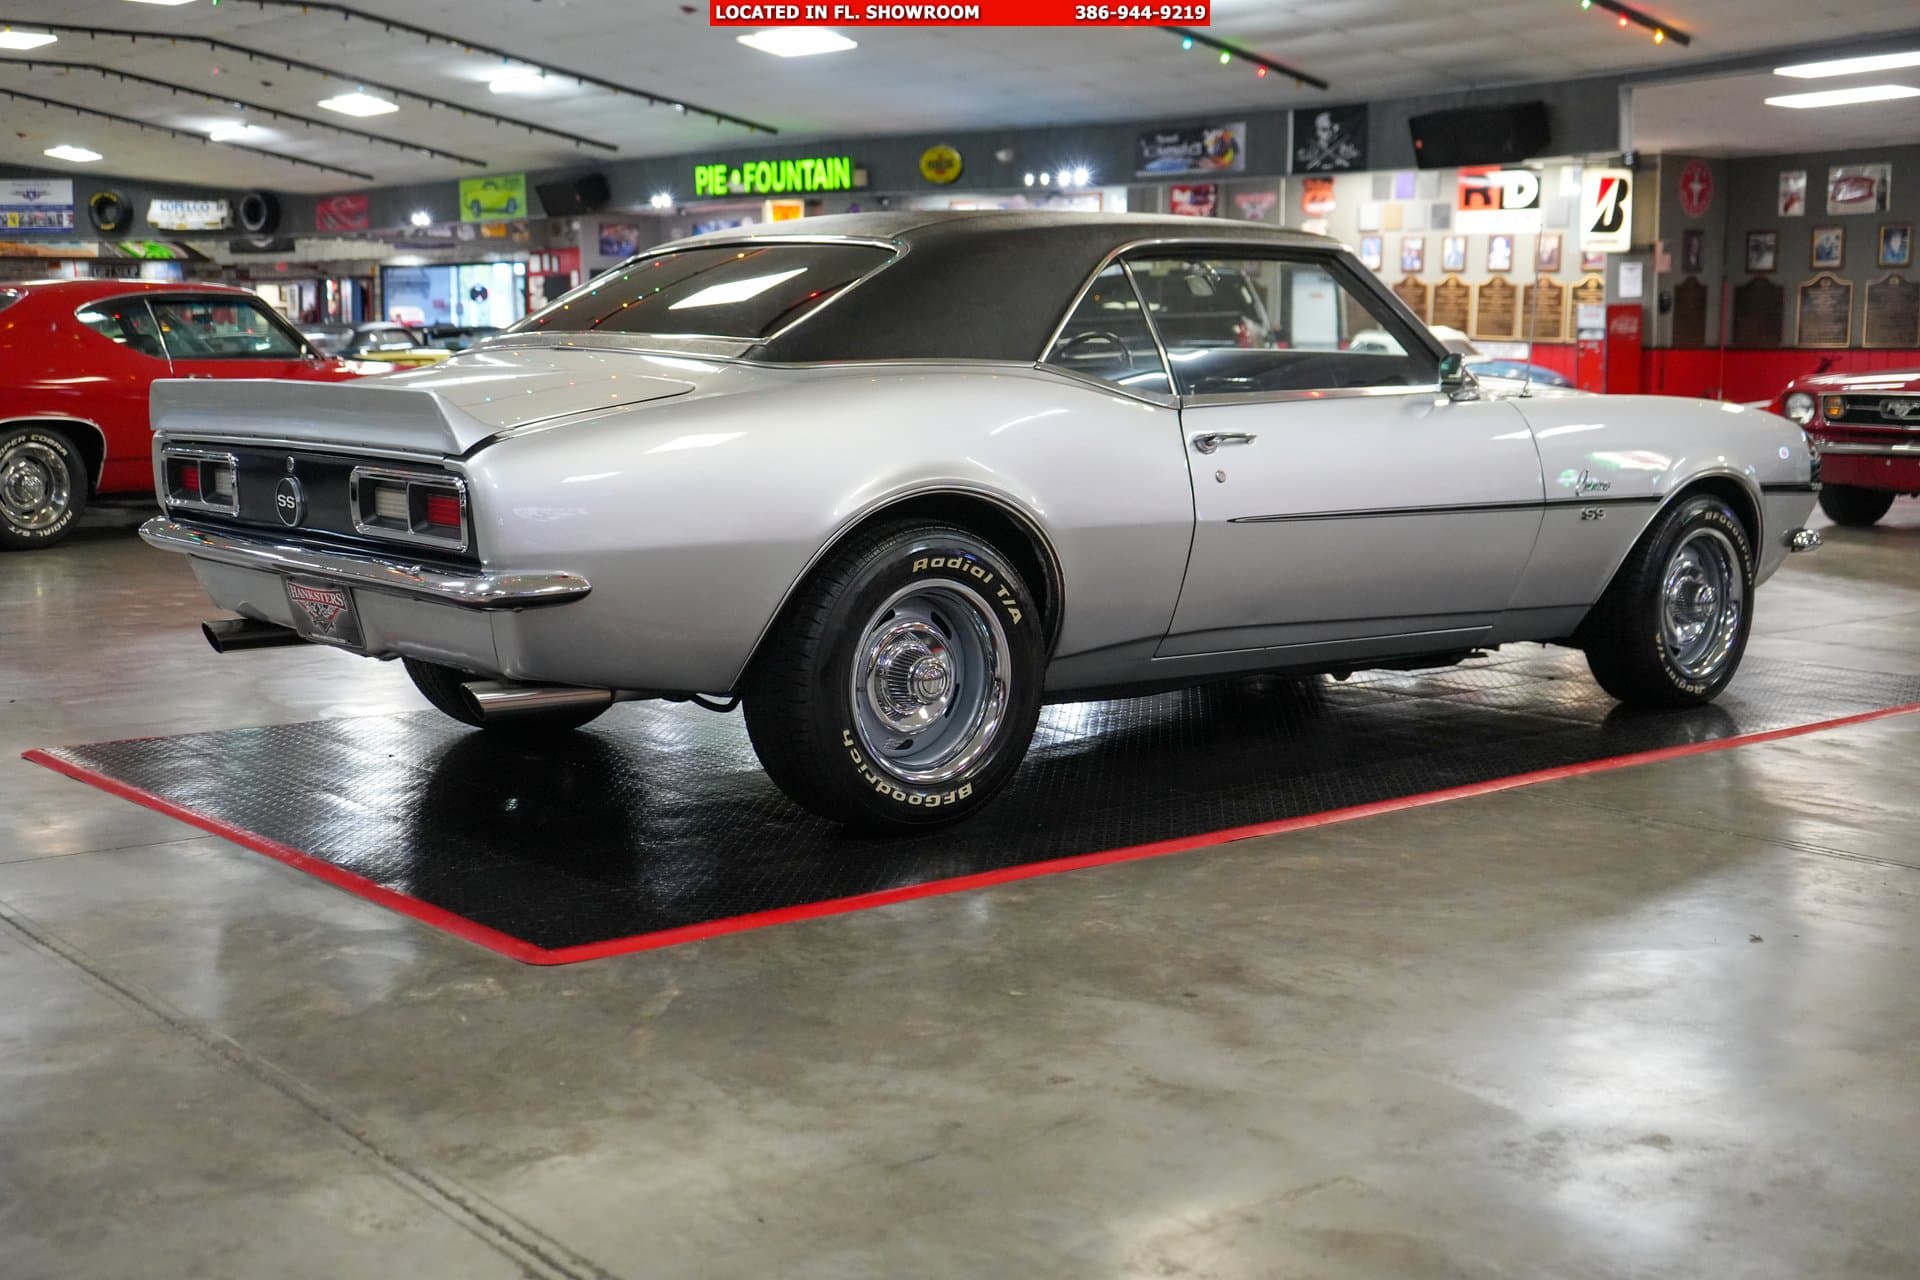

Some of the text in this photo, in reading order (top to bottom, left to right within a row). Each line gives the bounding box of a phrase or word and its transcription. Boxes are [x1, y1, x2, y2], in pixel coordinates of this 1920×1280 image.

[695, 157, 851, 196] PIE FOUNTAIN
[277, 494, 295, 509] SS
[289, 584, 345, 607] HANKSTERS
[912, 557, 1024, 625] Radial T/A
[842, 729, 974, 808] BFGoodrich
